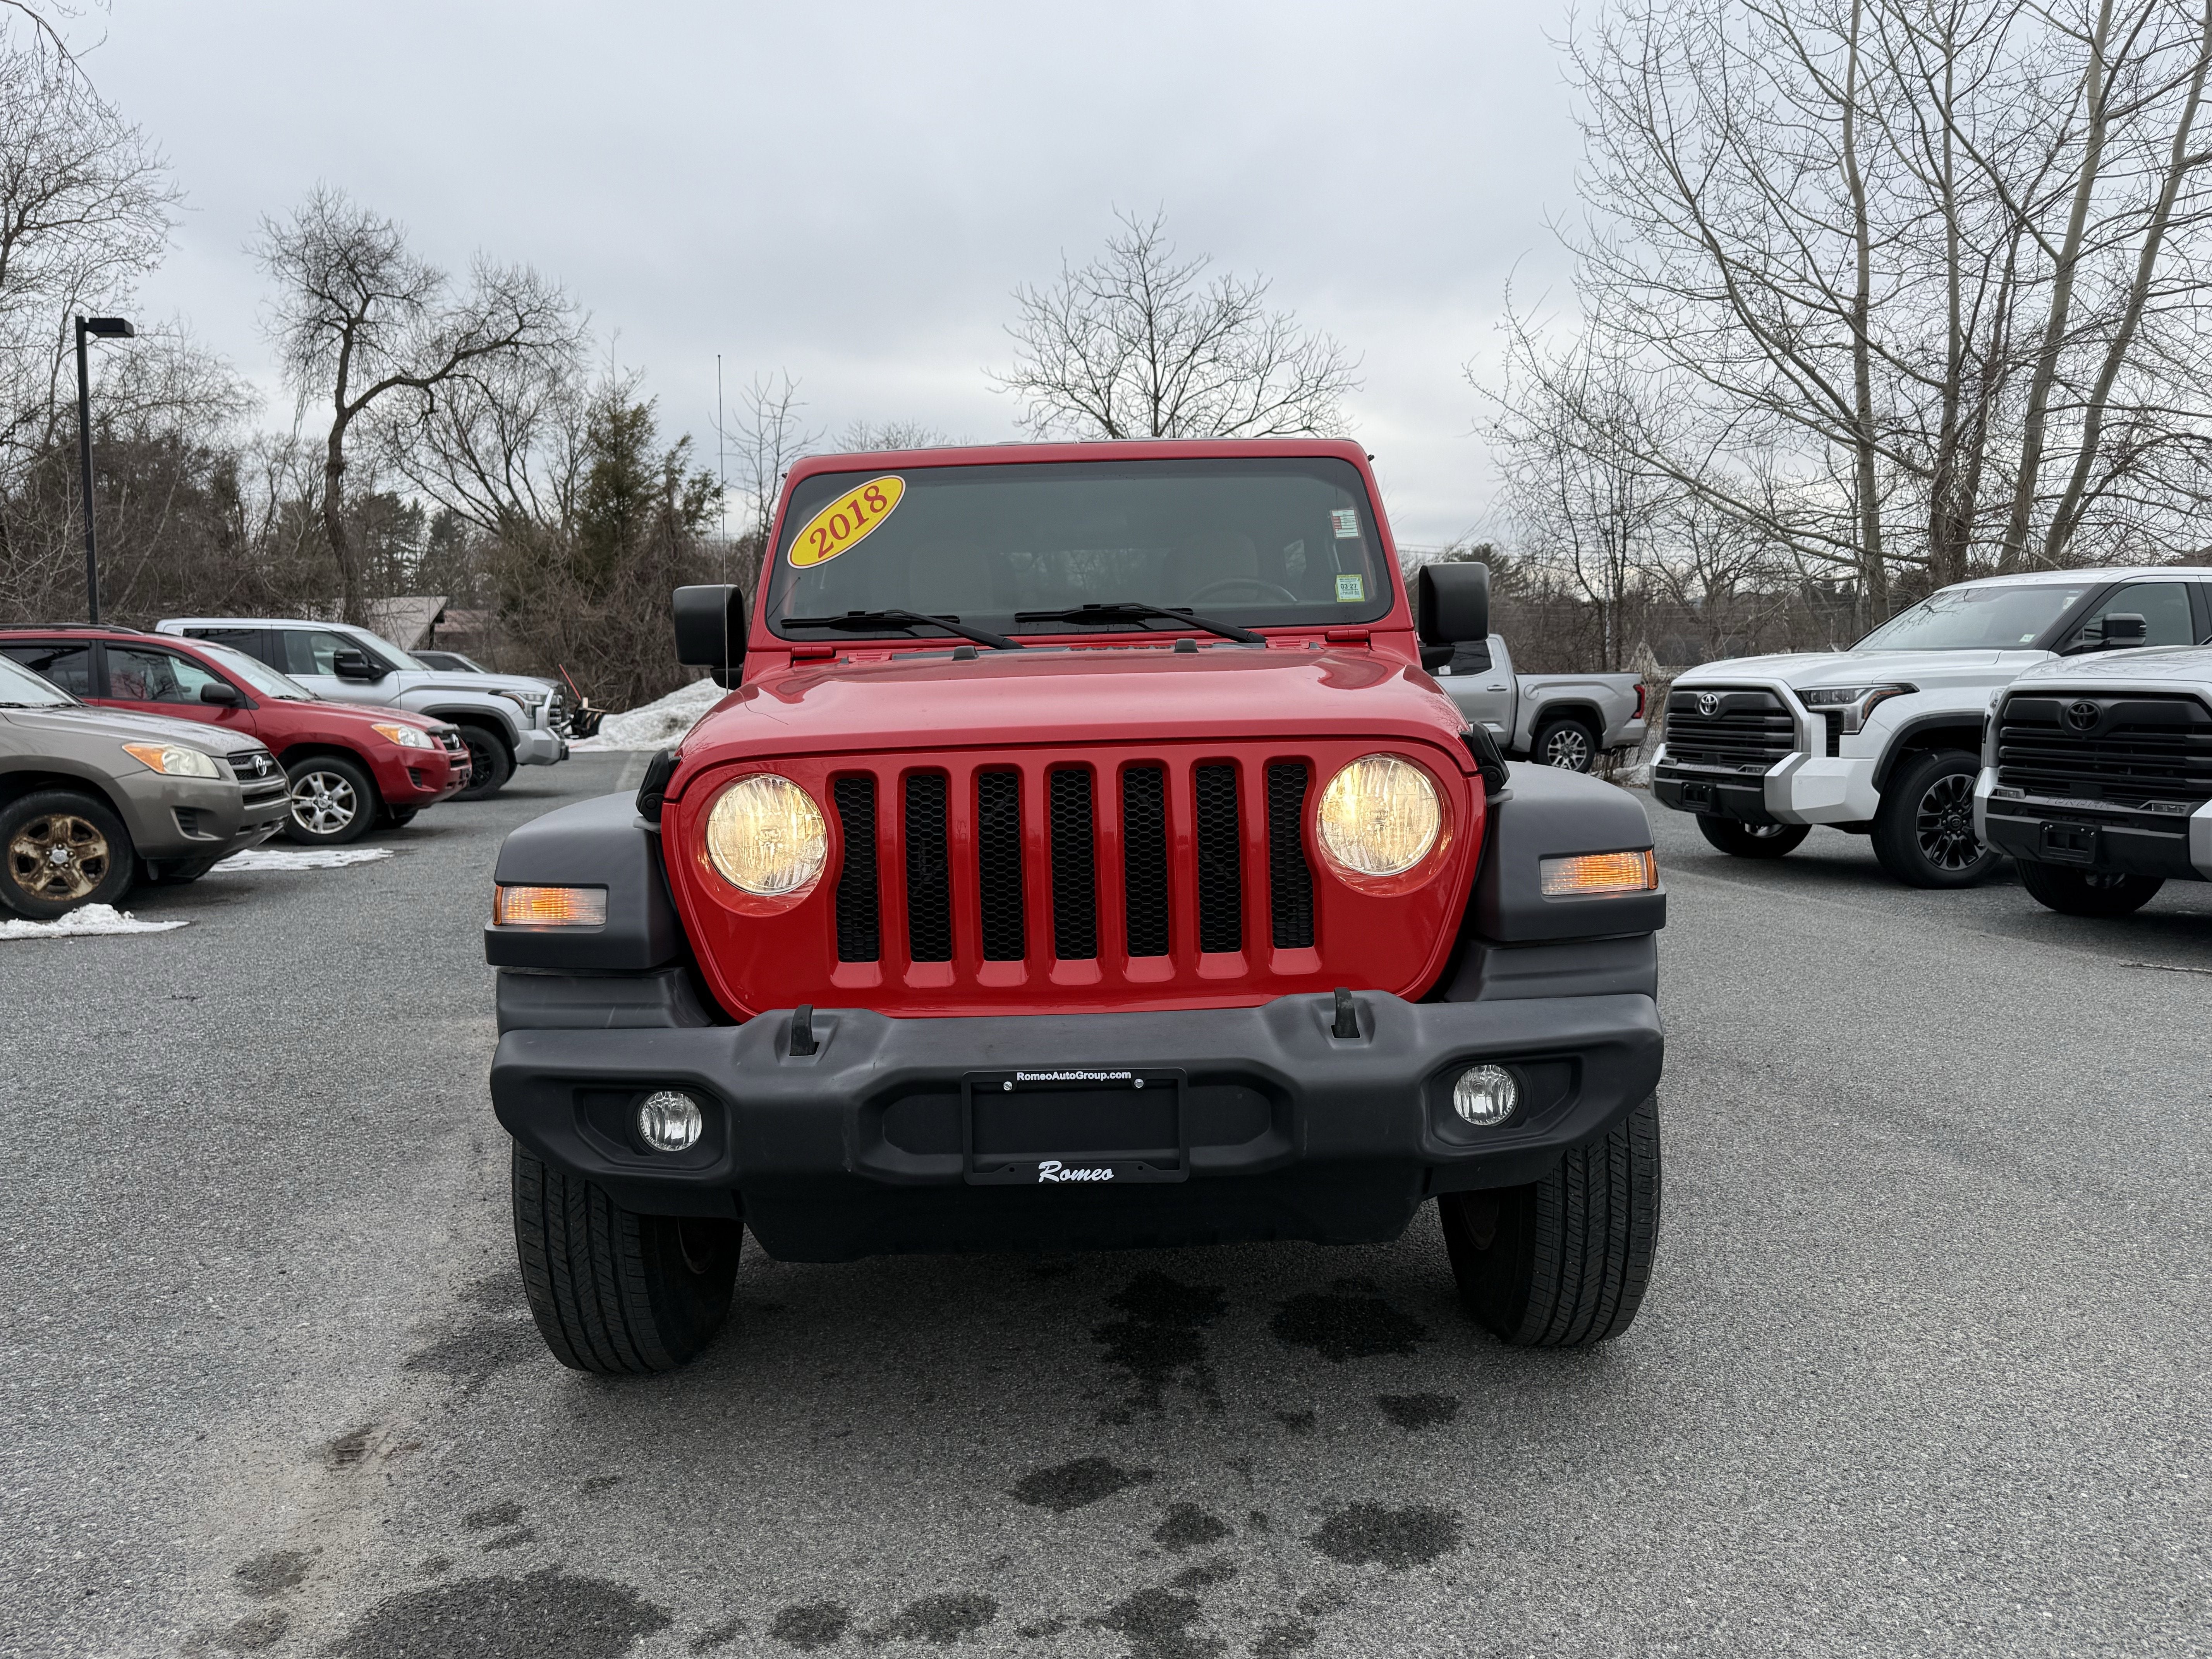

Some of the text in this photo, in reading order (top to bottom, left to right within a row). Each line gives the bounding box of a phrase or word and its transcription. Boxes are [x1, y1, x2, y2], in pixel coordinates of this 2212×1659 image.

[810, 485, 887, 558] 2018
[1017, 1071, 1131, 1081] RomeoAutoGroup.com
[1038, 1161, 1114, 1183] Romeo
